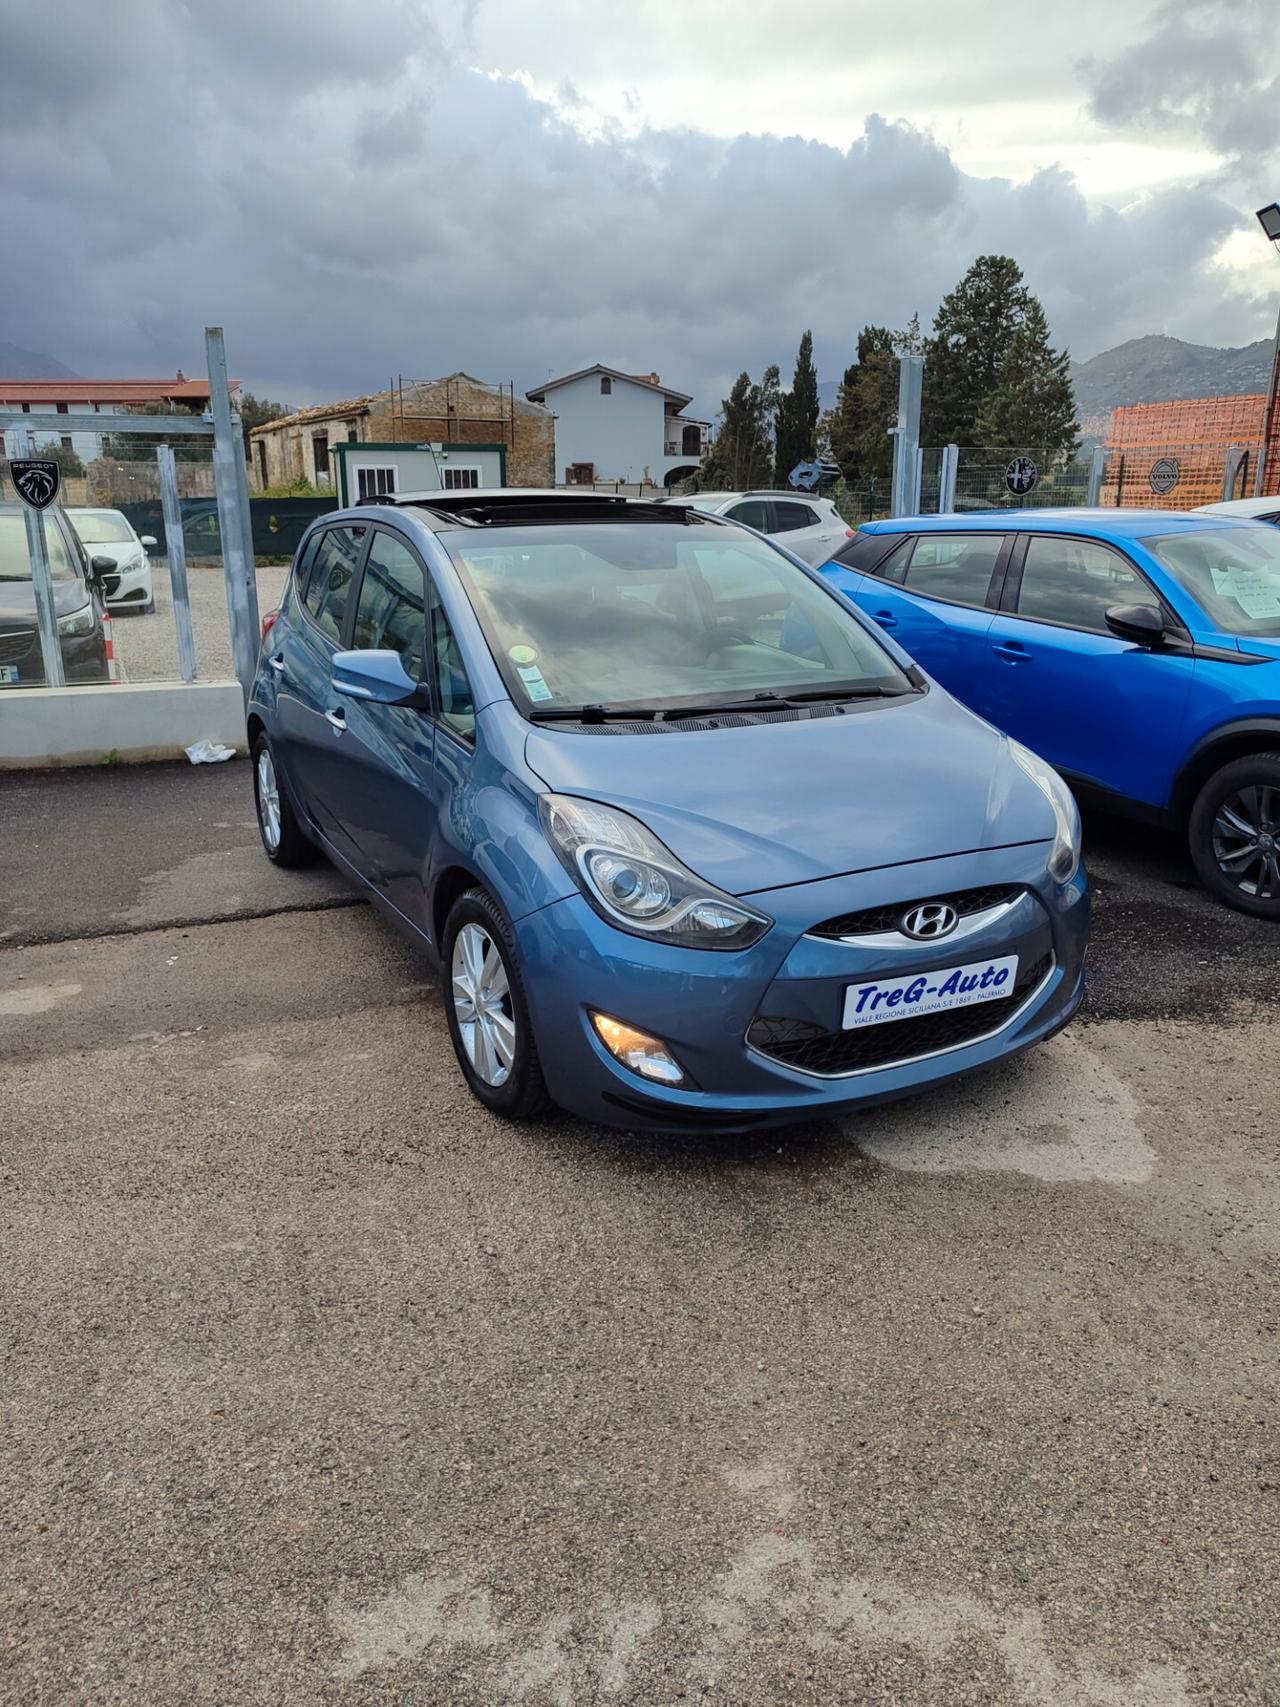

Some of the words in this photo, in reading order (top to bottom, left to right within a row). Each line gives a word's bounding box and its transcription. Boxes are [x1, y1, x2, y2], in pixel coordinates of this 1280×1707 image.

[854, 1014, 873, 1024] VIALE
[875, 1008, 905, 1020] REGIONE
[908, 1002, 940, 1014] SICILIANA
[977, 988, 1006, 1001] PALERMO
[855, 965, 1009, 1013] TreG-Auto
